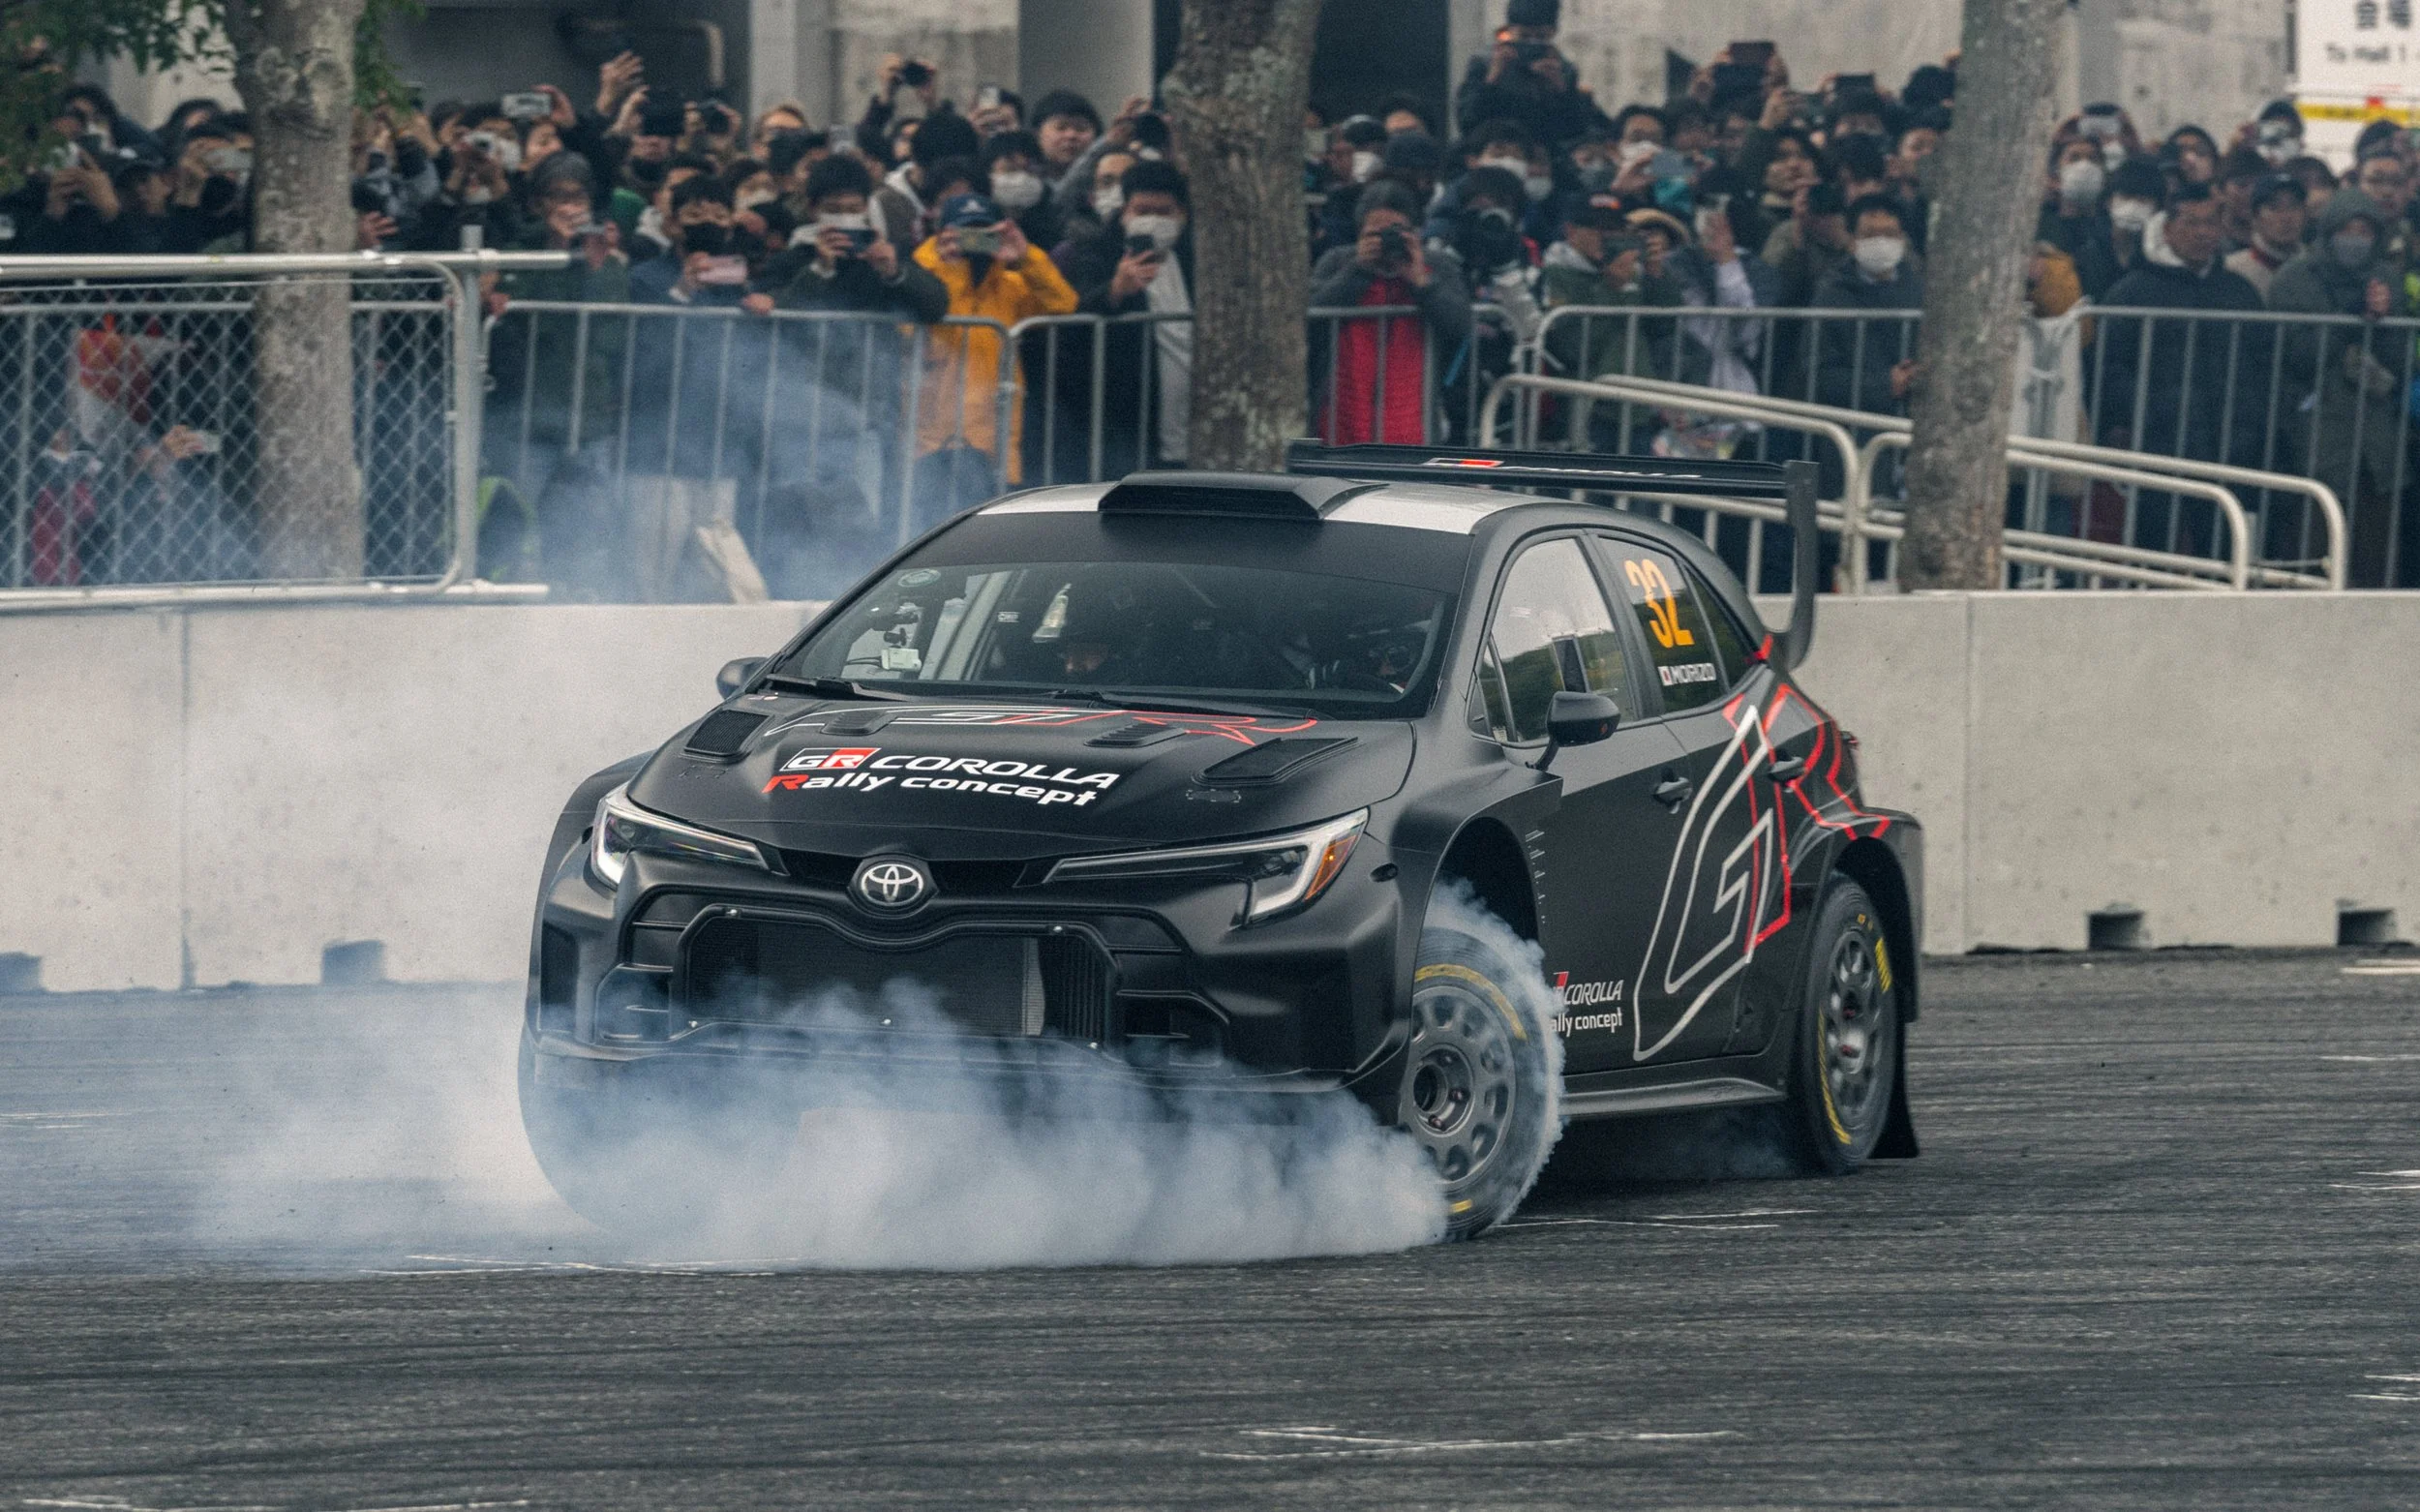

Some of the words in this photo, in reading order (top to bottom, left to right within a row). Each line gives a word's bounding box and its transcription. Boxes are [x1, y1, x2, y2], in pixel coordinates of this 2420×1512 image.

[1623, 559, 1695, 649] 32
[784, 751, 865, 771] GR
[869, 755, 1120, 789] COROLLA
[761, 772, 897, 793] Rally
[900, 776, 1098, 806] concept
[1564, 980, 1623, 1005] COROLLA
[1550, 1013, 1573, 1037] ally
[1575, 1007, 1622, 1033] concept
